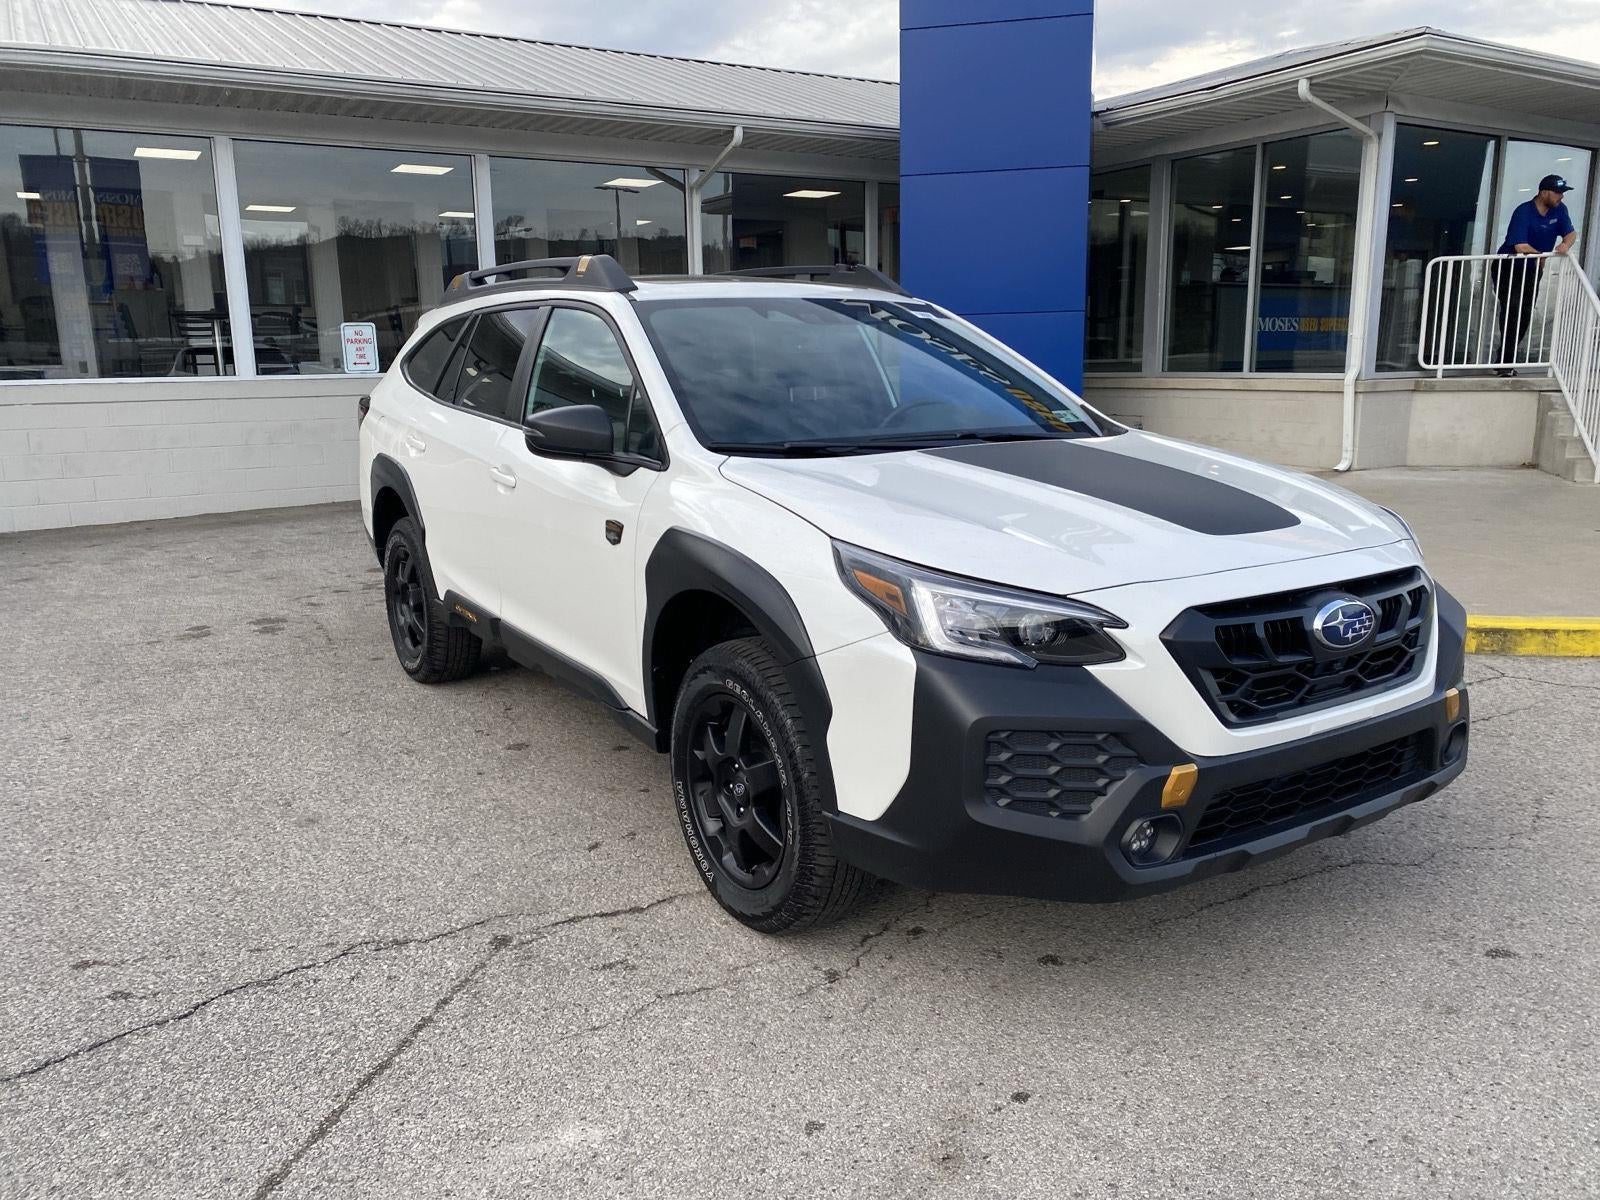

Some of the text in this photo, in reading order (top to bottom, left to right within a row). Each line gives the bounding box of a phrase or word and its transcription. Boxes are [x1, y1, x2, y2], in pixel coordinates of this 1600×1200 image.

[1257, 316, 1299, 331] MOSES
[346, 337, 373, 345] PARKING
[676, 781, 715, 882] YOKOHAMA
